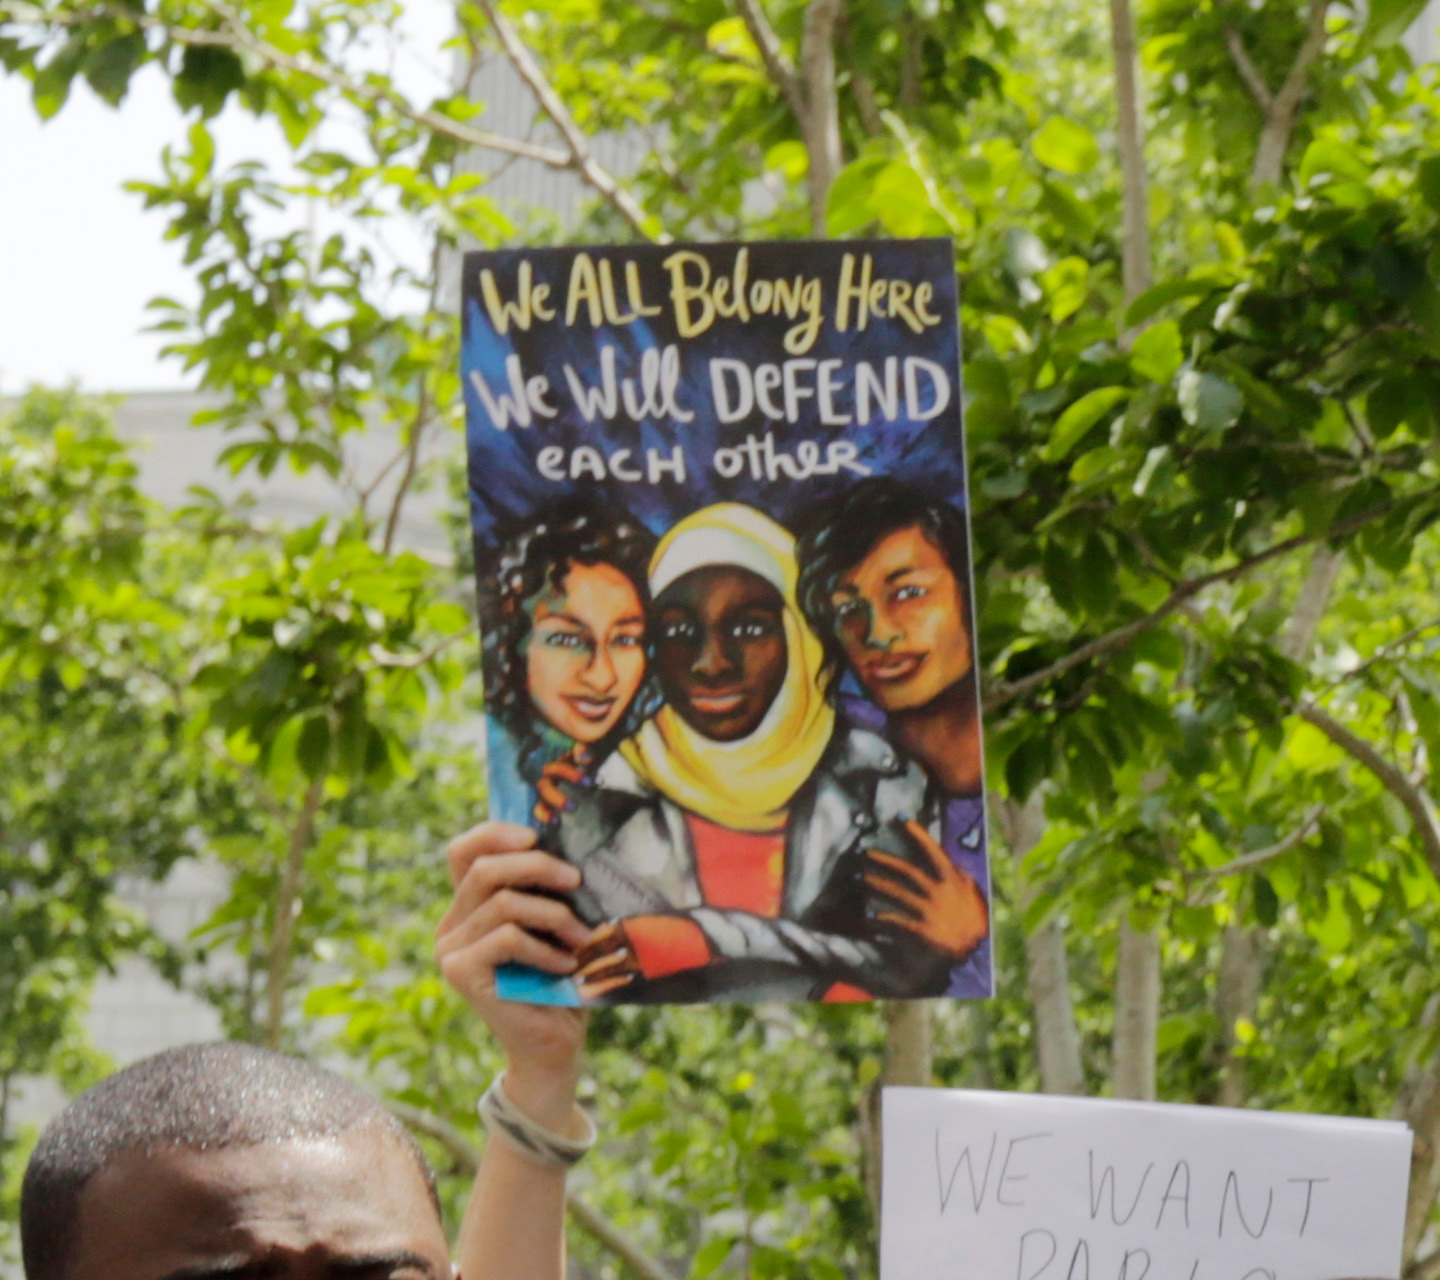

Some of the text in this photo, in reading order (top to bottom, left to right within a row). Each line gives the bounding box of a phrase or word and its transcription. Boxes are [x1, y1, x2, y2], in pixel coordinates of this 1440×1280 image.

[480, 257, 556, 336] We
[565, 252, 662, 329] ALL
[469, 353, 559, 431] We
[563, 344, 695, 424] Will
[934, 1127, 1331, 1241] WE WANT
